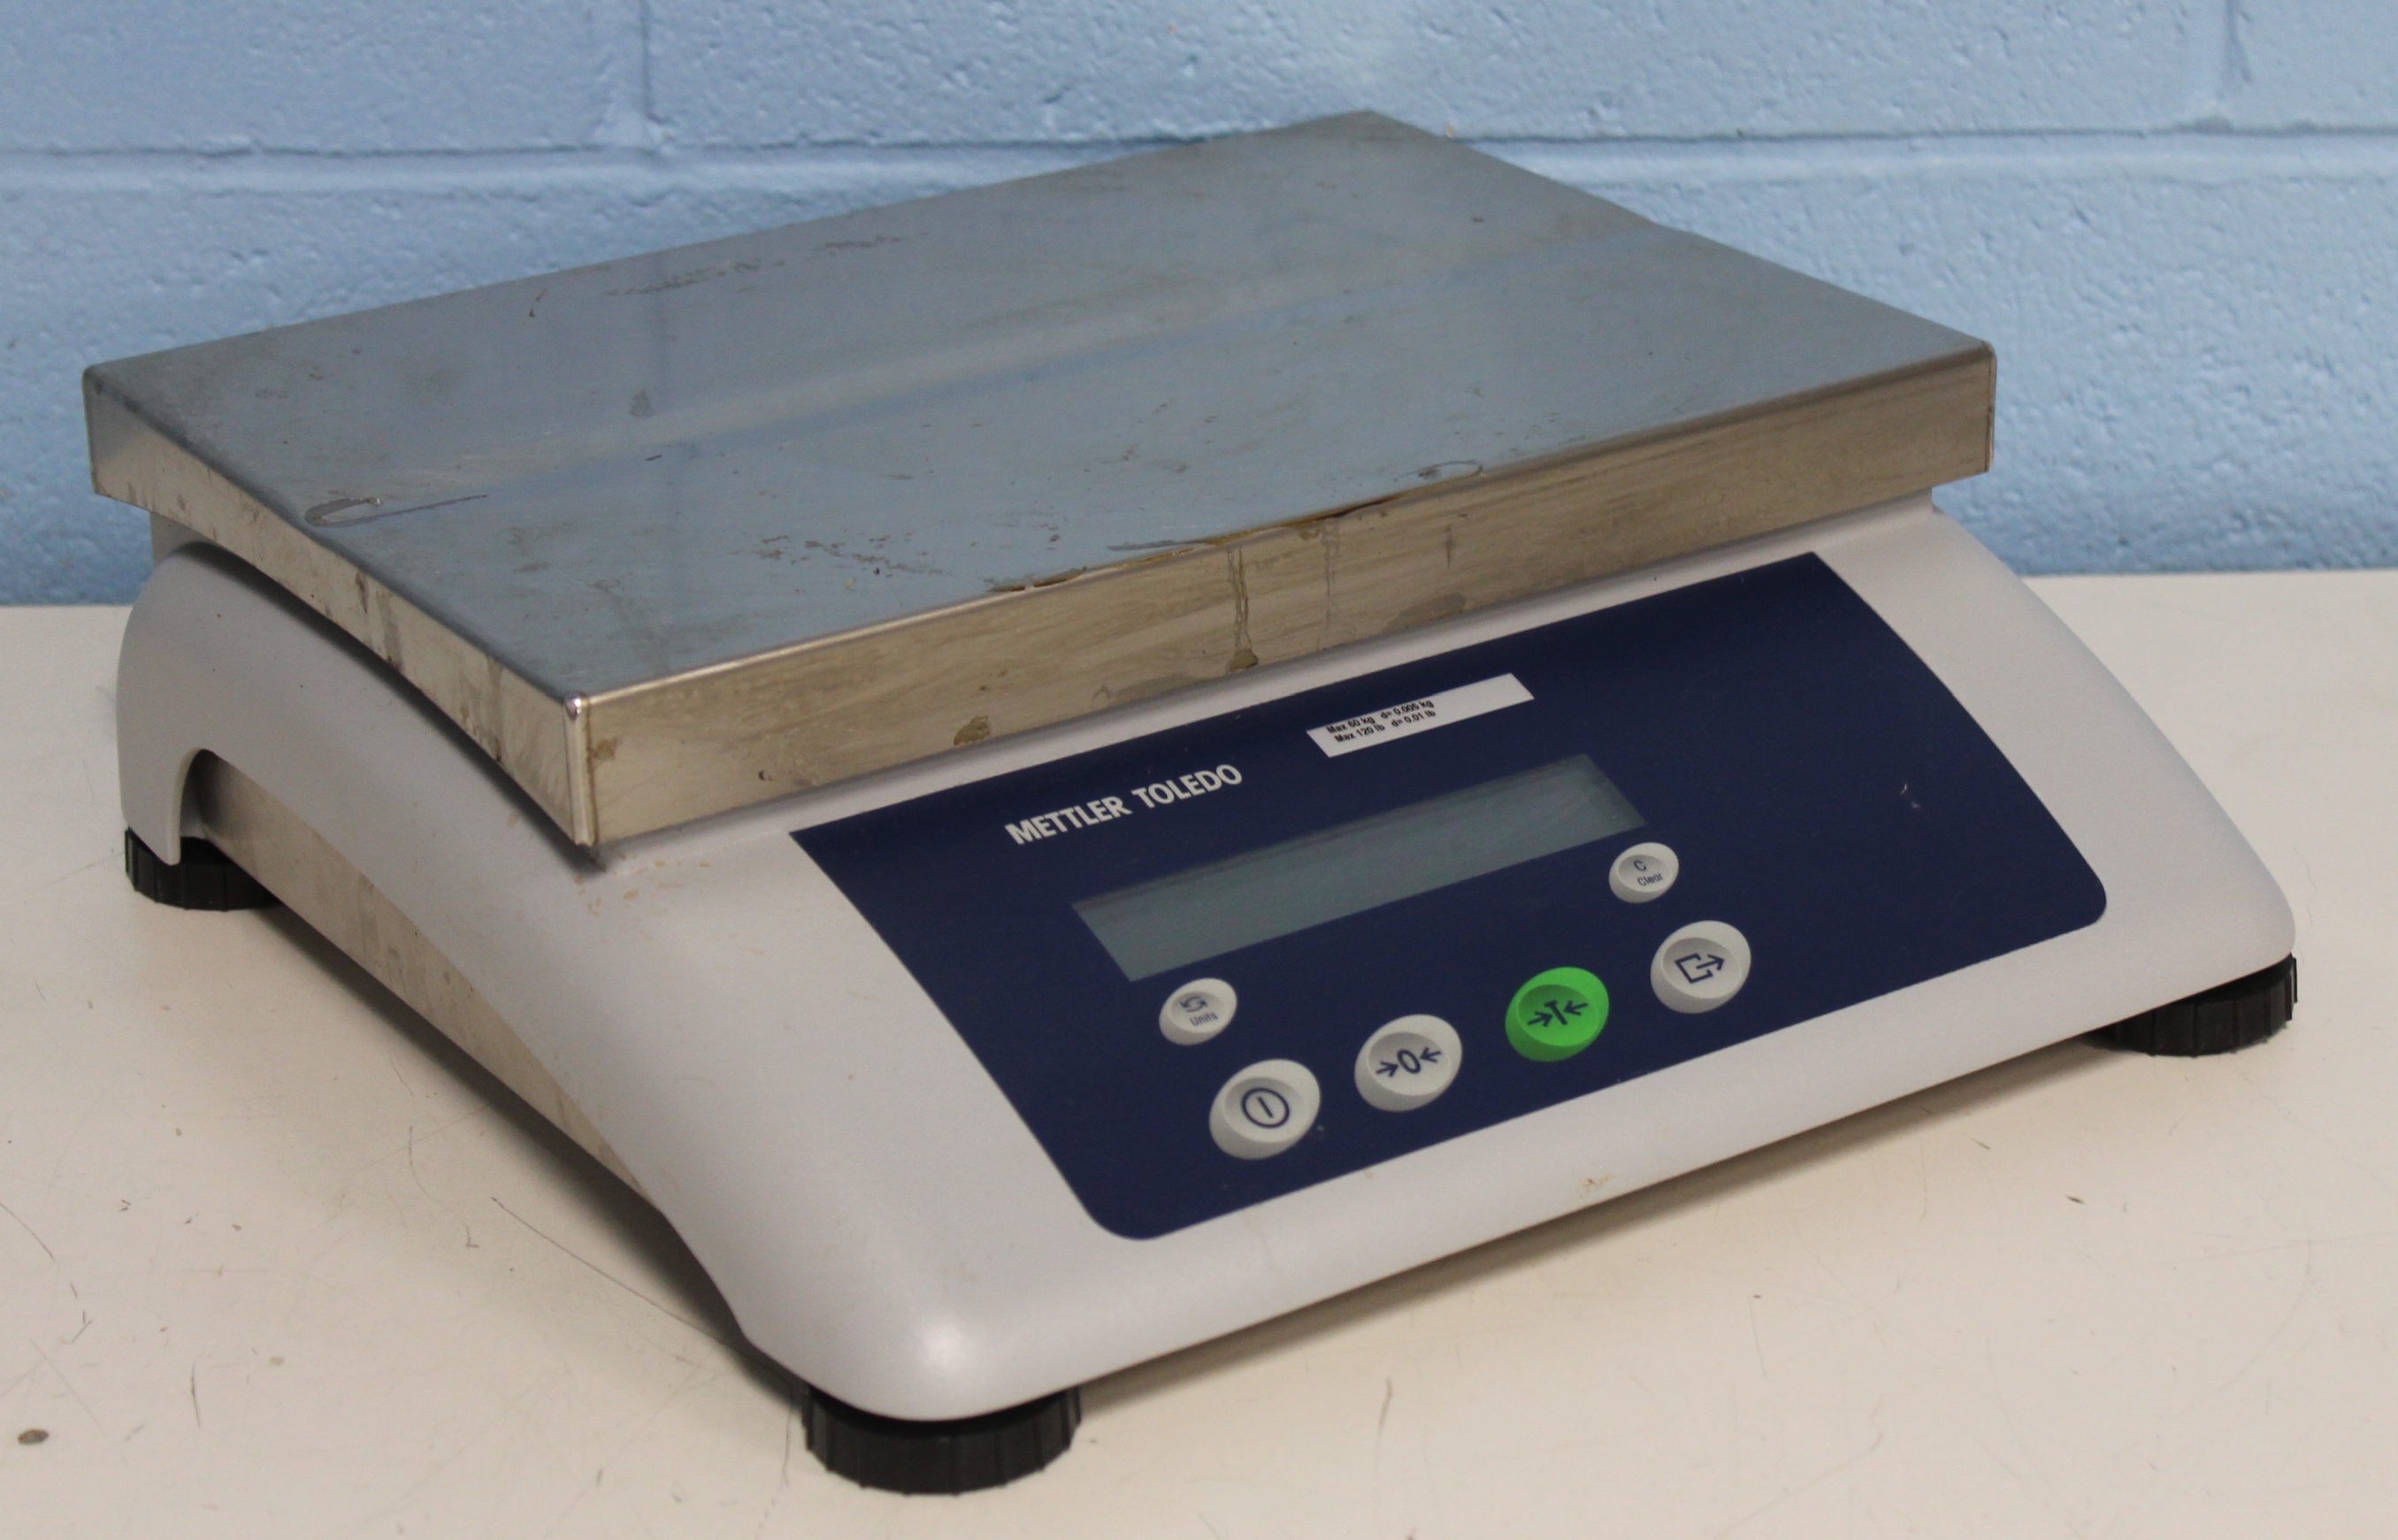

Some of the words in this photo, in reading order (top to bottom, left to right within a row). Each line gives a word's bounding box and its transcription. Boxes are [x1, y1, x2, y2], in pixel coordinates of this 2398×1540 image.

[1327, 724, 1346, 733] Max
[1393, 702, 1419, 715] 0.005
[1334, 732, 1355, 743] Max
[1356, 727, 1374, 737] 120
[1404, 713, 1425, 724] 0.01
[1004, 796, 1132, 845] METTLER
[1131, 764, 1243, 808] TOLEDO
[1634, 860, 1647, 871] C
[1637, 873, 1663, 885] Clear
[1189, 1013, 1218, 1026] Units
